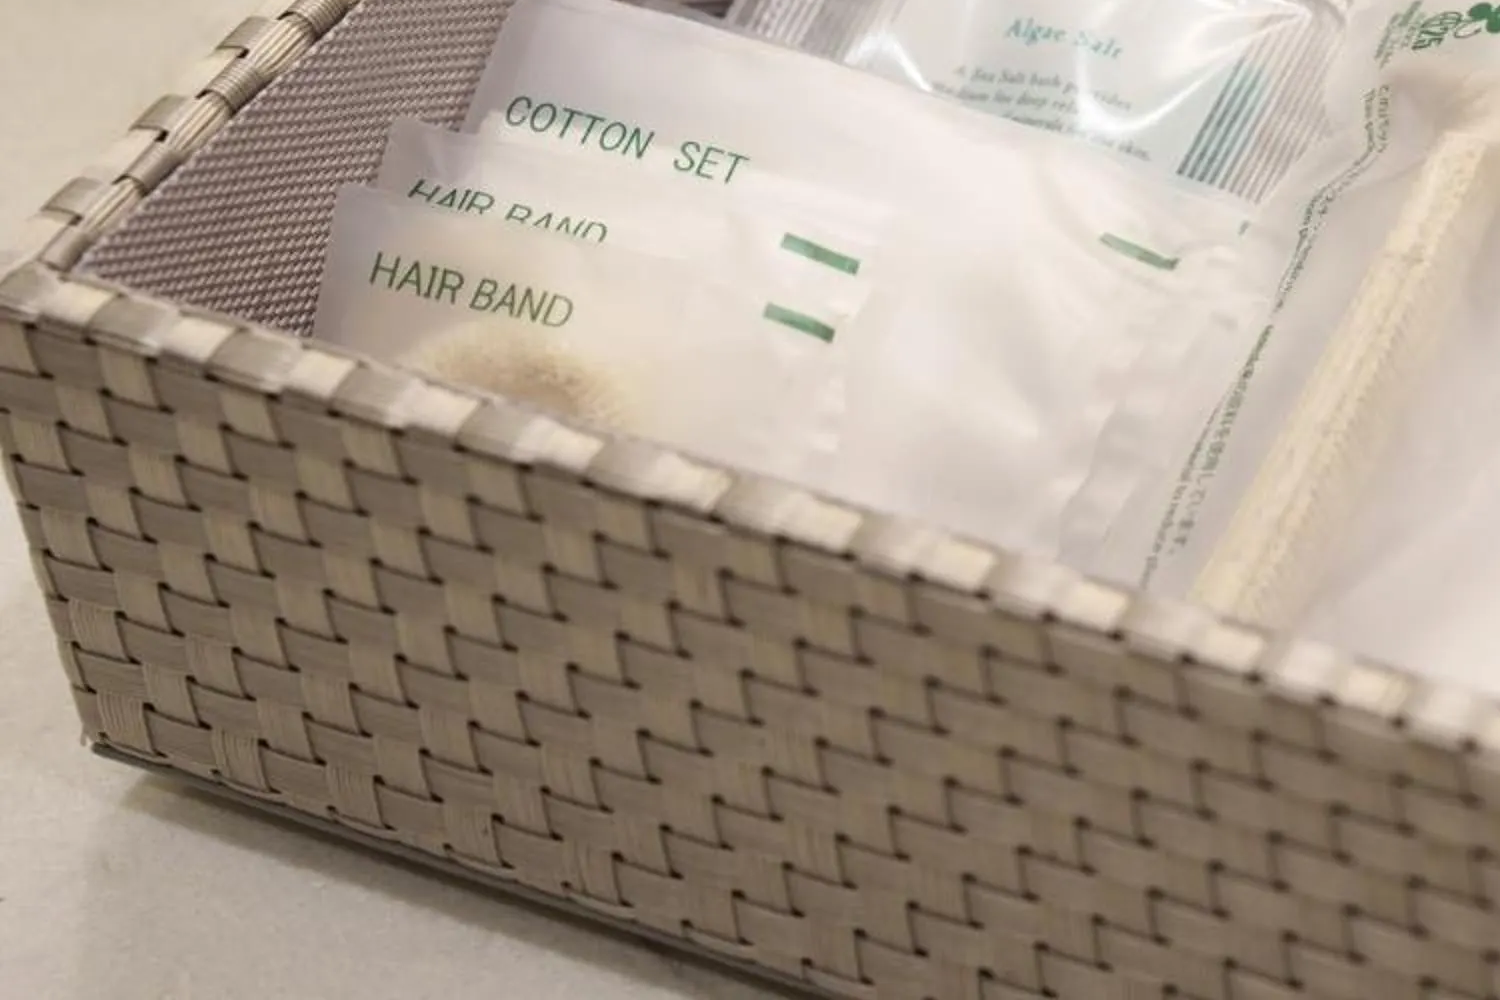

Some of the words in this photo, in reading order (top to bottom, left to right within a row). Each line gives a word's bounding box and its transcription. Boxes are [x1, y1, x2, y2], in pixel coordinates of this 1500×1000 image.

[1005, 17, 1067, 48] Algae
[506, 96, 655, 160] COTTON
[673, 139, 750, 185] SET
[407, 179, 496, 216] HAIR
[369, 251, 466, 305] HAIR
[469, 278, 575, 329] BAND
